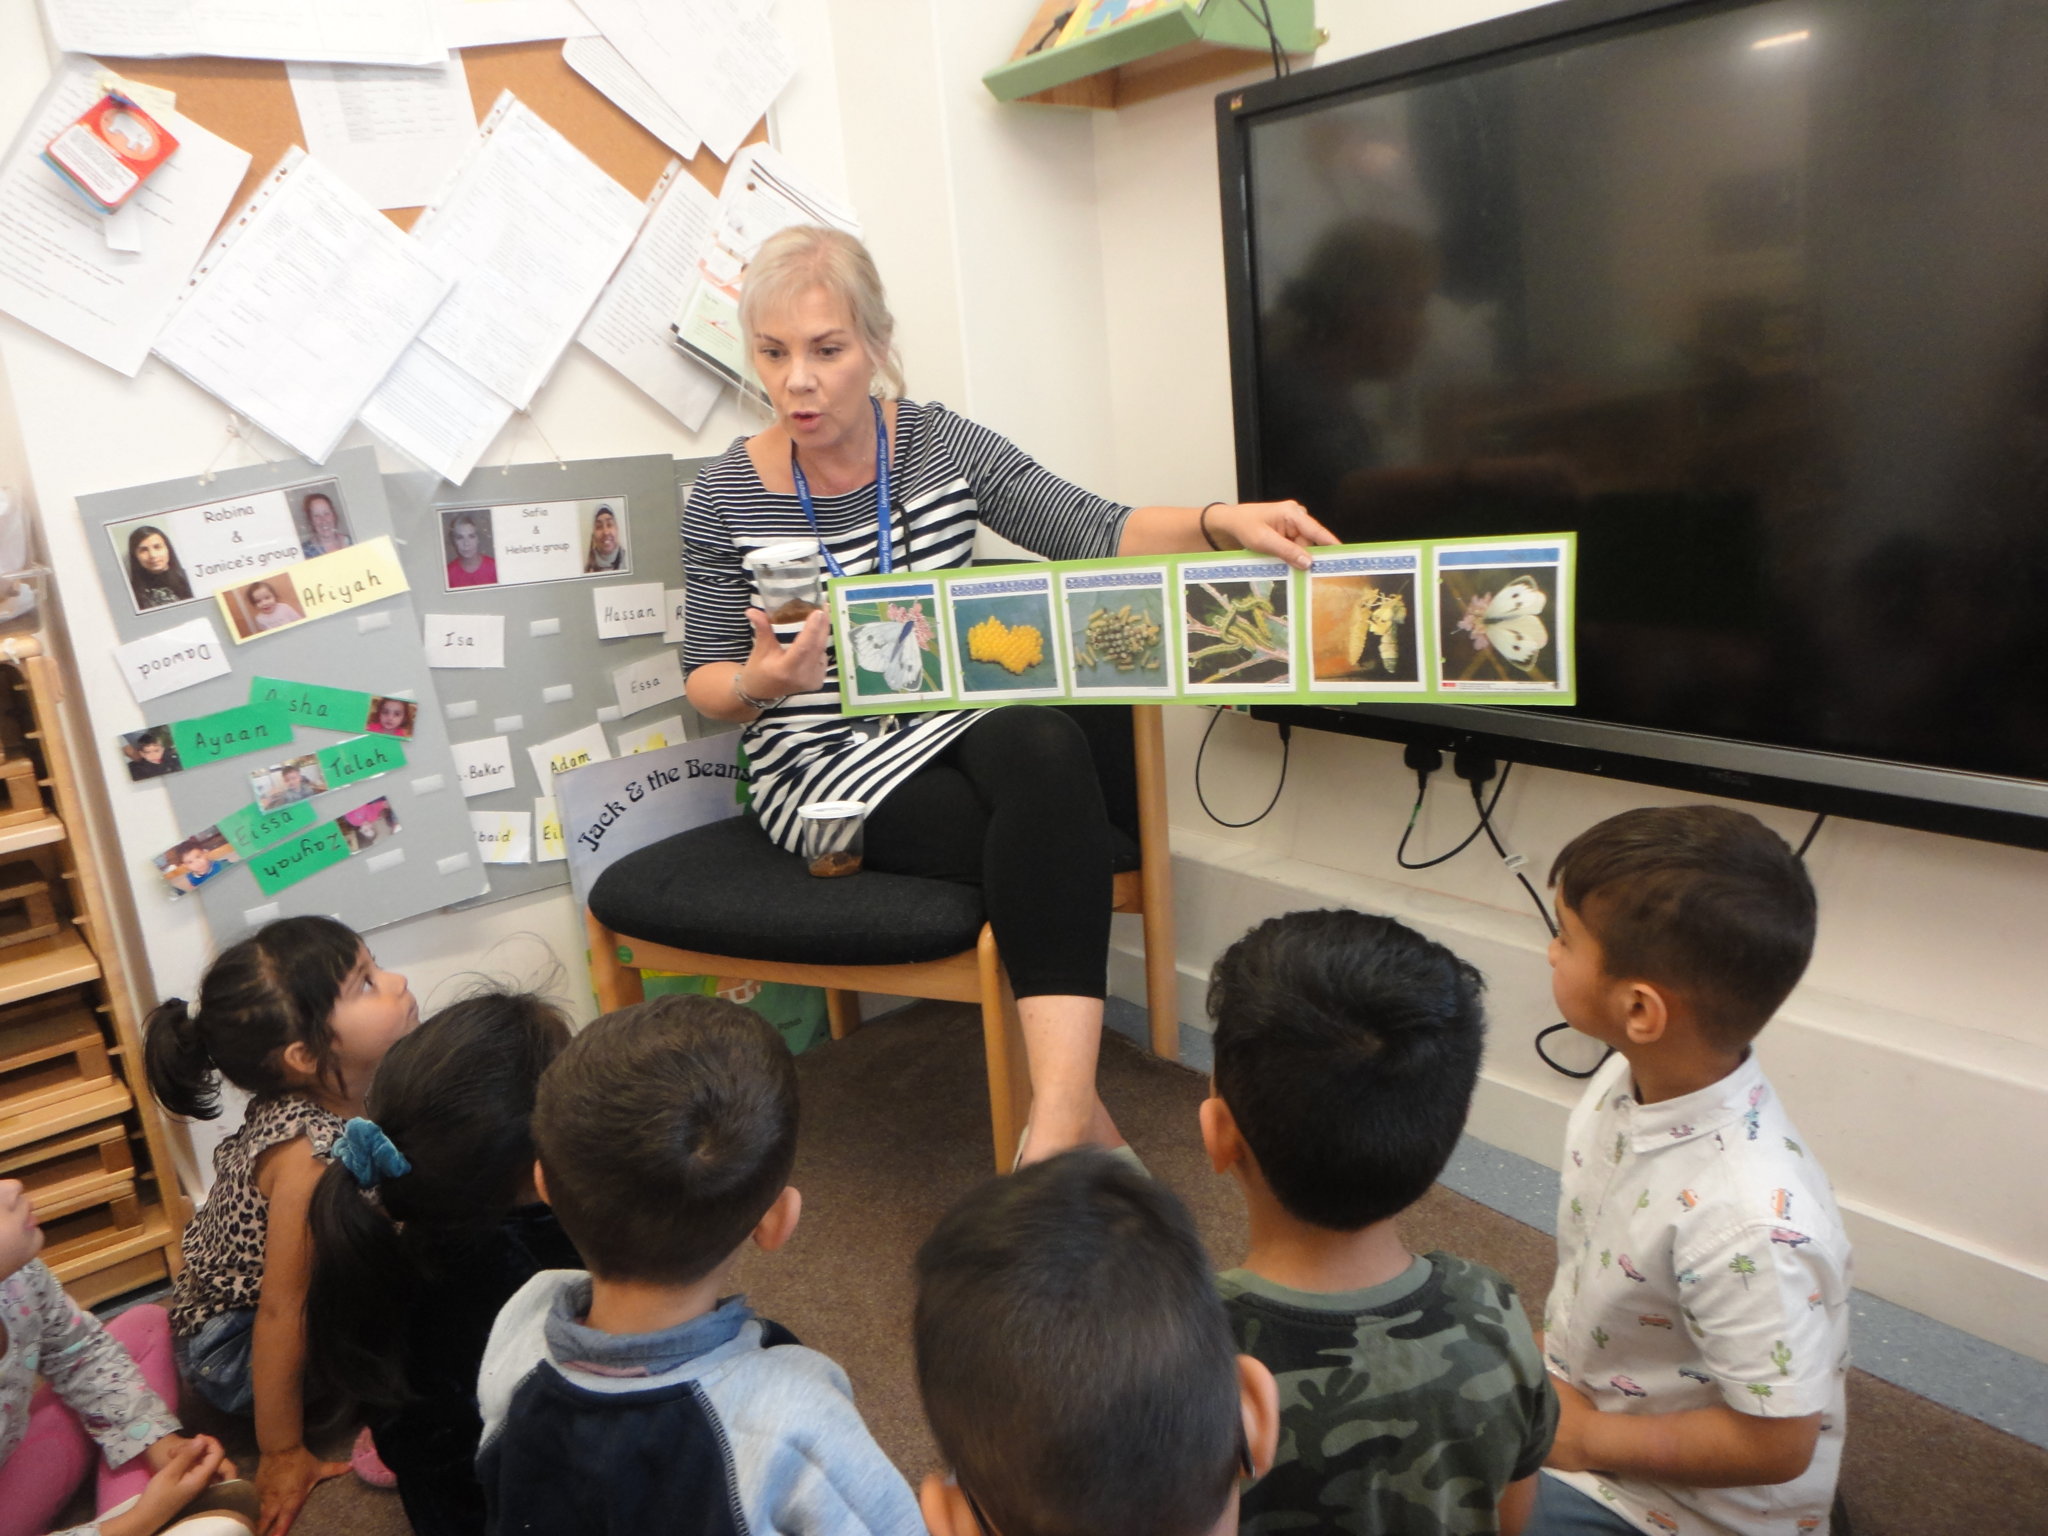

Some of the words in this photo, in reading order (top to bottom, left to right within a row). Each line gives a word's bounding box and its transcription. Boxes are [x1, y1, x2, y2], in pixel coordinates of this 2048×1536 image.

[203, 505, 255, 523] Robina
[232, 530, 243, 543] &
[542, 542, 570, 554] group
[195, 555, 255, 577] Janice's
[258, 546, 298, 567] group
[303, 569, 382, 607] Afiyah
[604, 606, 656, 624] Hassan
[444, 631, 475, 647] Isa
[139, 644, 212, 678] Dawood
[631, 677, 661, 694] Essa
[195, 724, 269, 756] Ayaan
[551, 752, 592, 773] Adam
[577, 800, 627, 852] Jack
[625, 780, 645, 803] &
[646, 766, 681, 791] the
[263, 833, 342, 878] Zaynah
